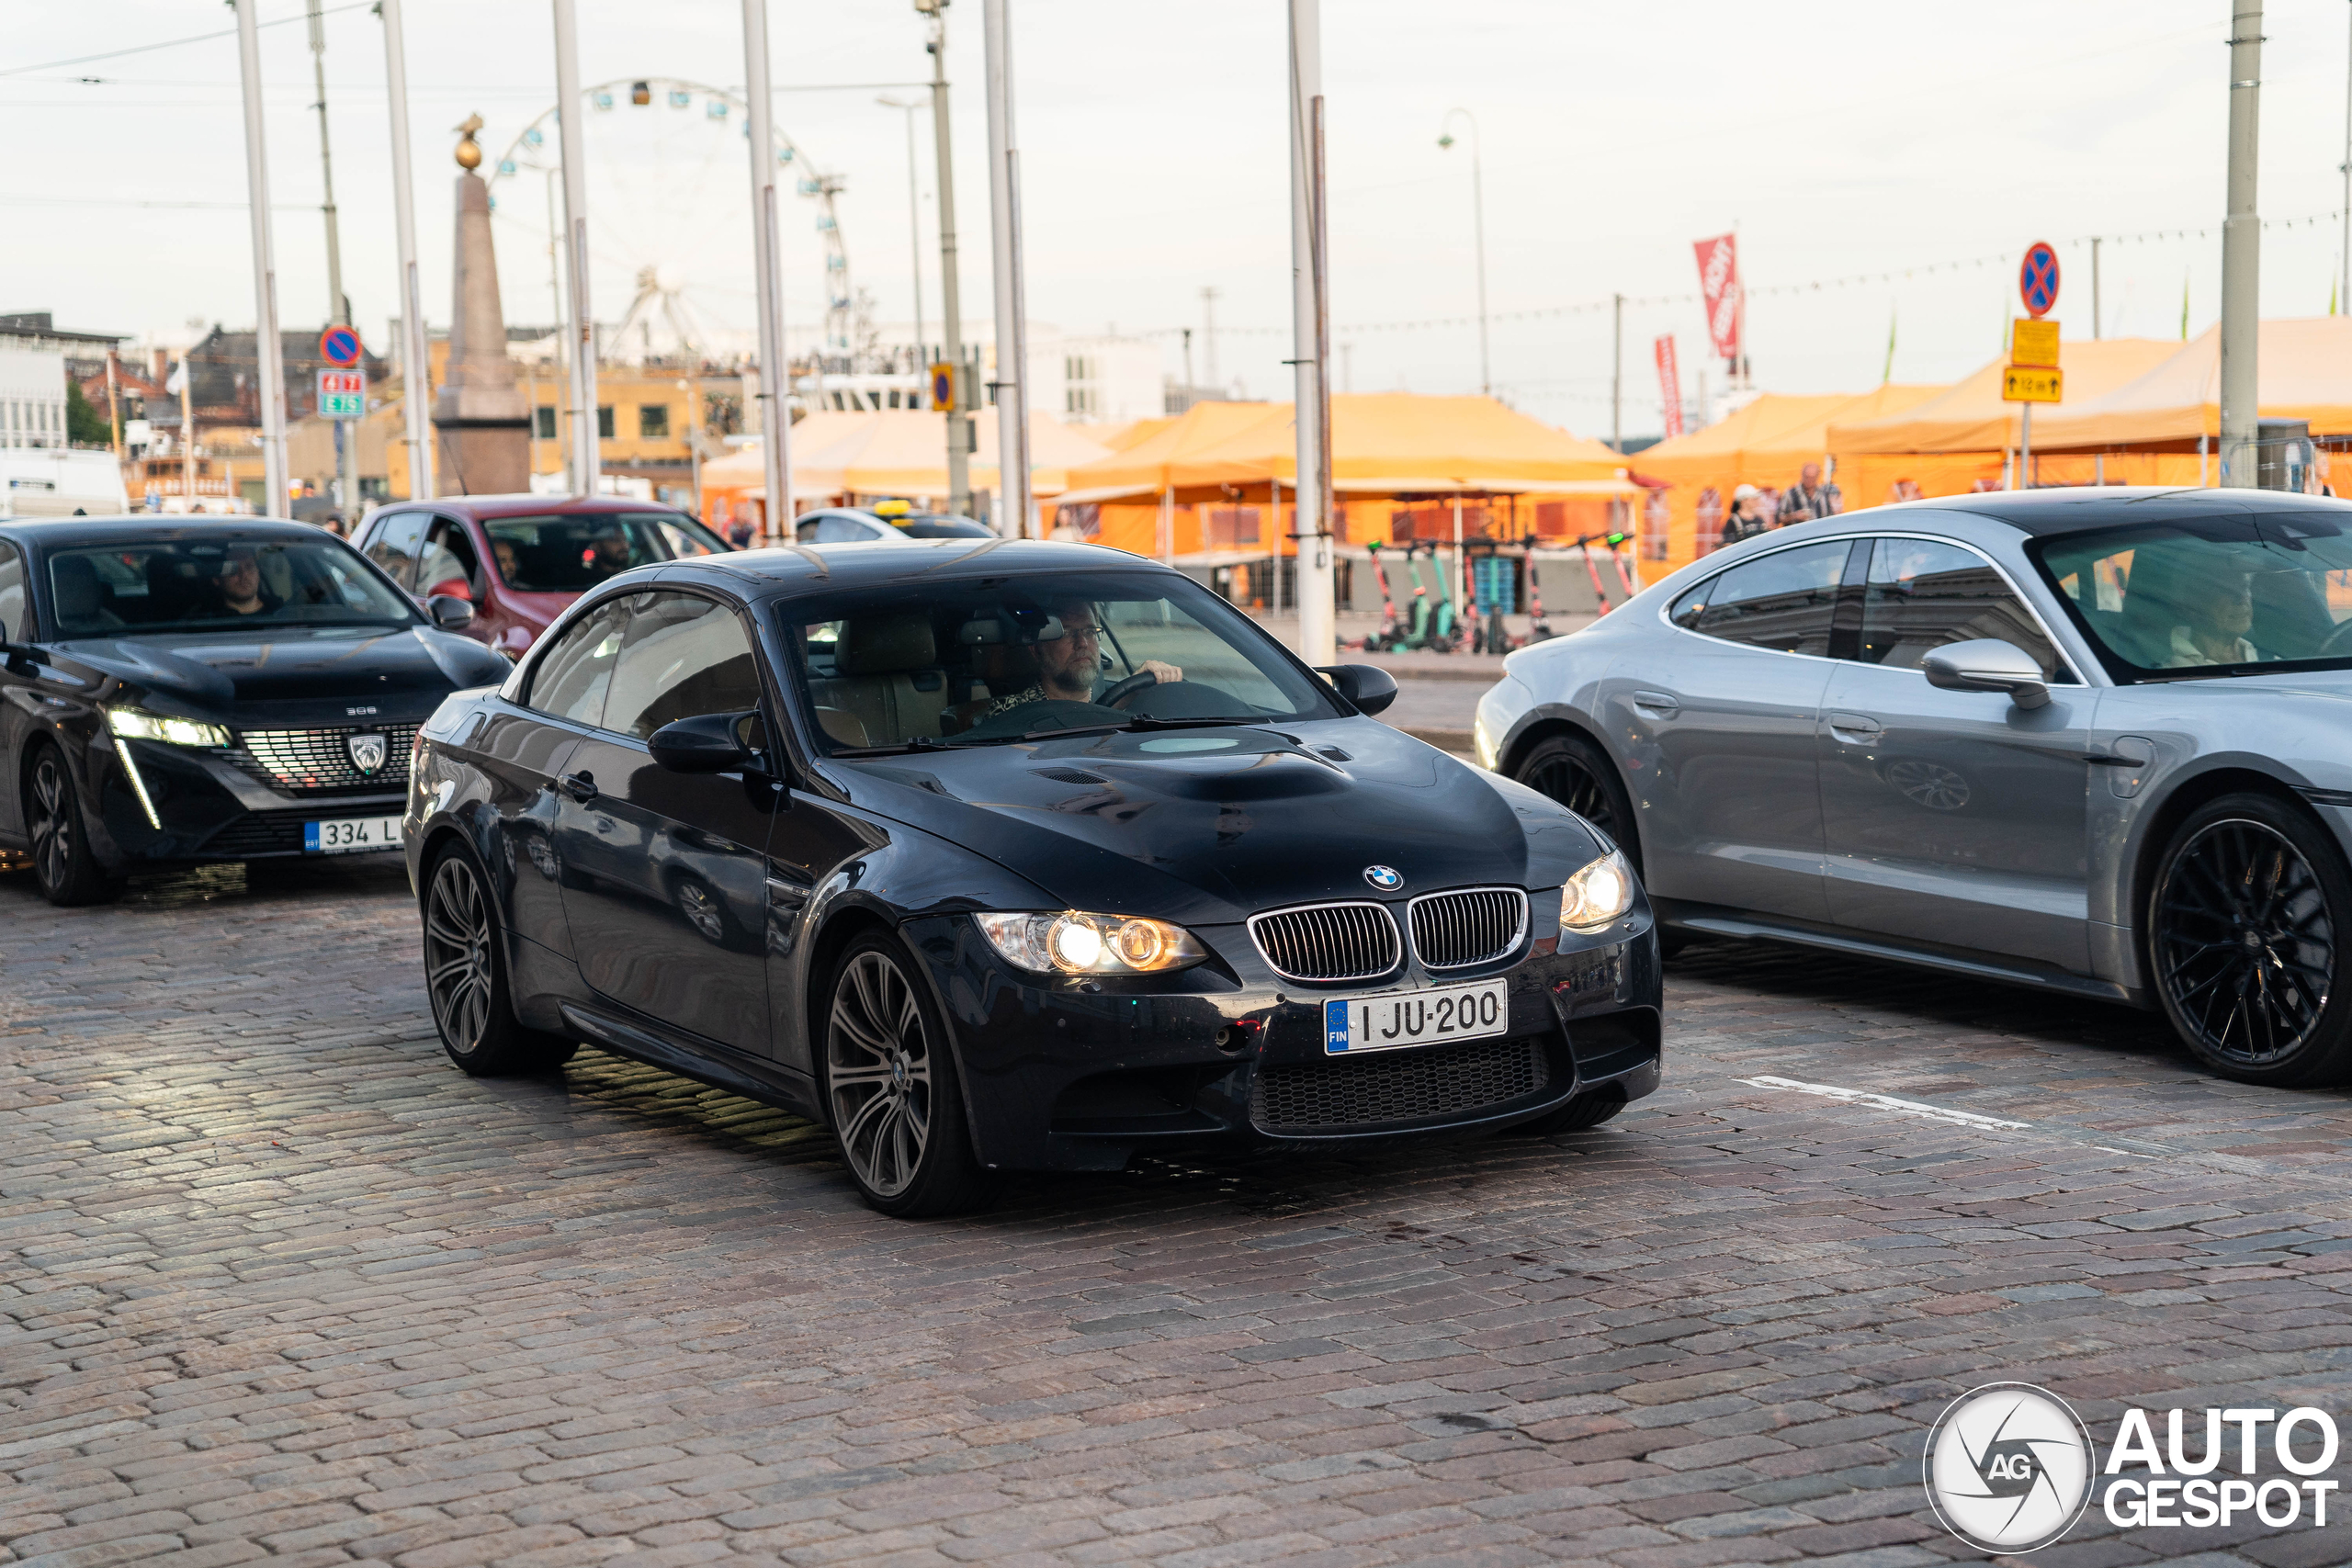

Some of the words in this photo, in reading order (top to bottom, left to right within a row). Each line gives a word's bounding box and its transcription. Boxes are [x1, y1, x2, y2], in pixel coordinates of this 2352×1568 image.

[346, 706, 377, 716] 308
[325, 821, 368, 845] 334
[383, 818, 405, 841] L
[305, 840, 320, 848] EST
[1329, 1030, 1348, 1043] FIN
